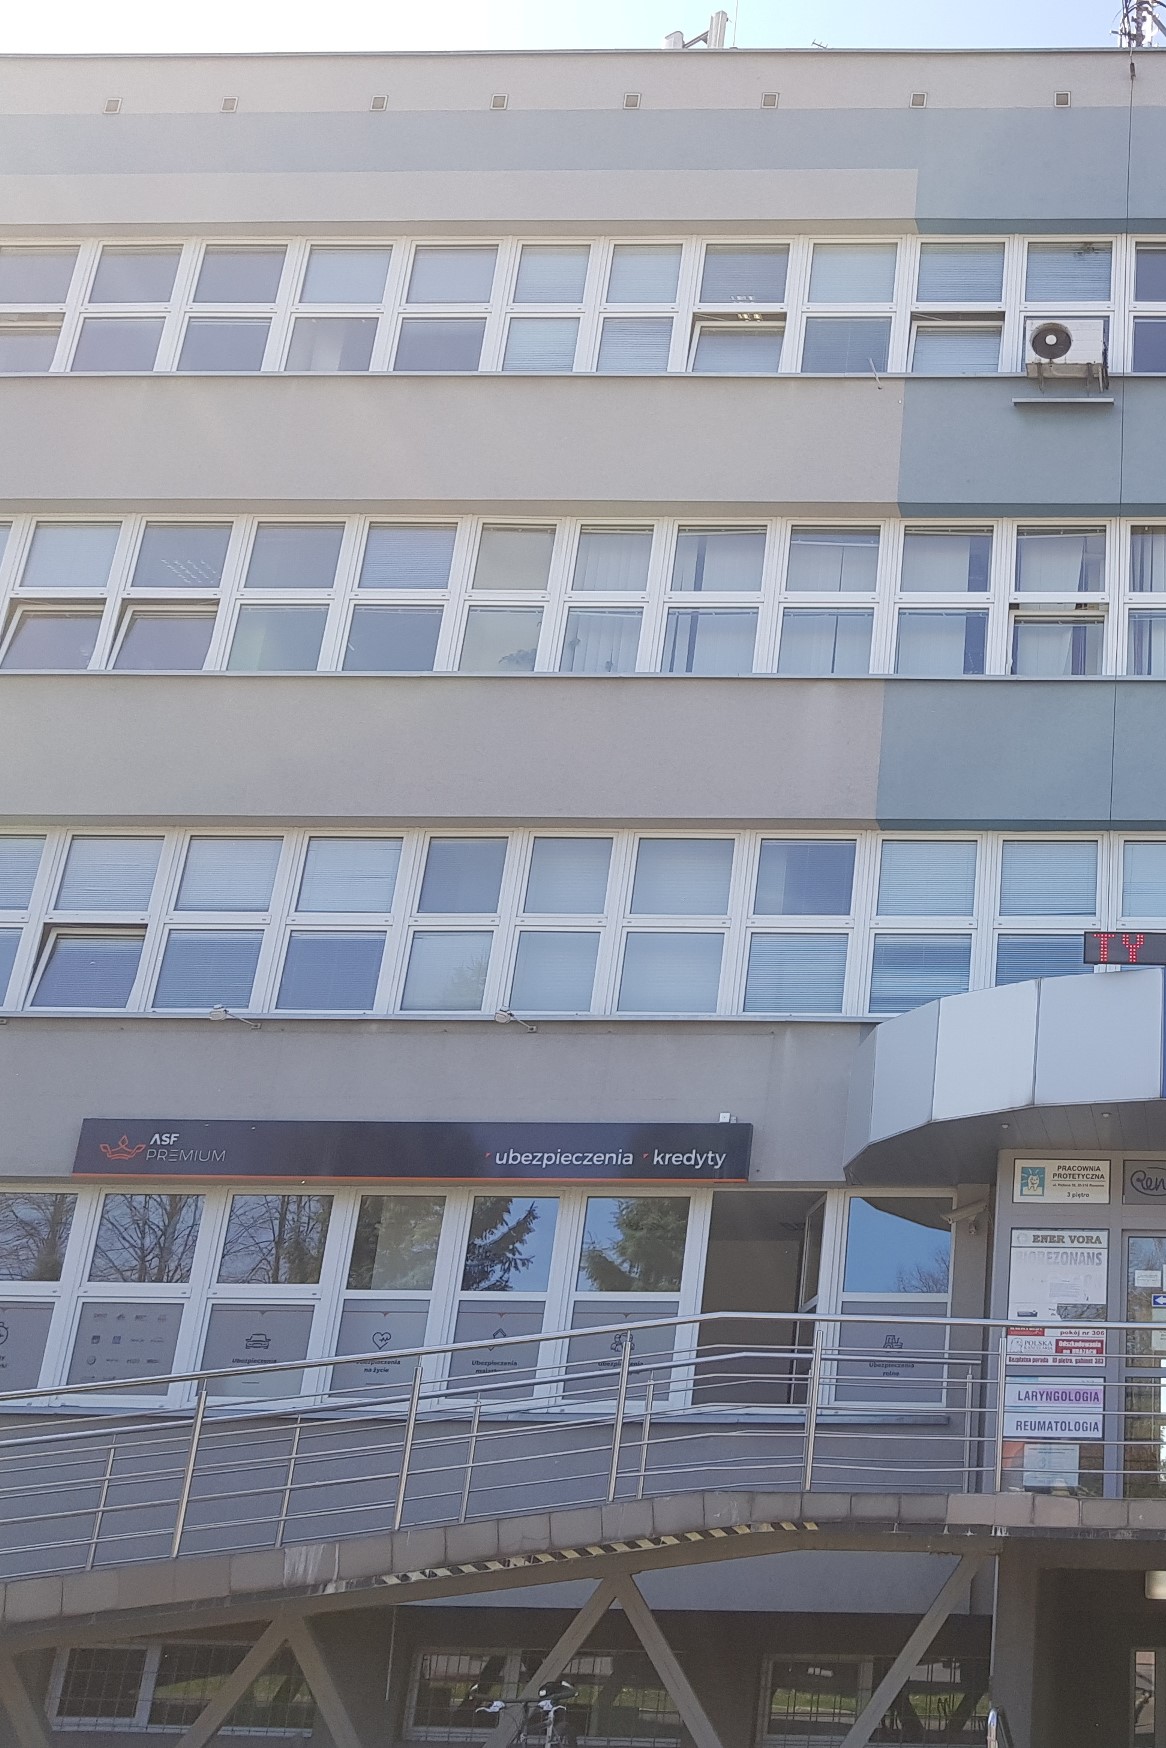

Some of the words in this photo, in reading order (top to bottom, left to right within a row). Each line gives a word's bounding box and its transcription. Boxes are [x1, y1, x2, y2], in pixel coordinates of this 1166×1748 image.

[1093, 934, 1144, 962] TY
[150, 1133, 179, 1145] ASF
[146, 1149, 226, 1162] PREMIUM
[495, 1149, 633, 1168] ubezpieczenia
[653, 1149, 726, 1168] kredyty
[1032, 1234, 1065, 1244] ENER
[1068, 1235, 1102, 1244] VORA
[1018, 1390, 1100, 1402] LARYNGOLOGIA
[1015, 1420, 1100, 1432] REUMATOLOGIA
